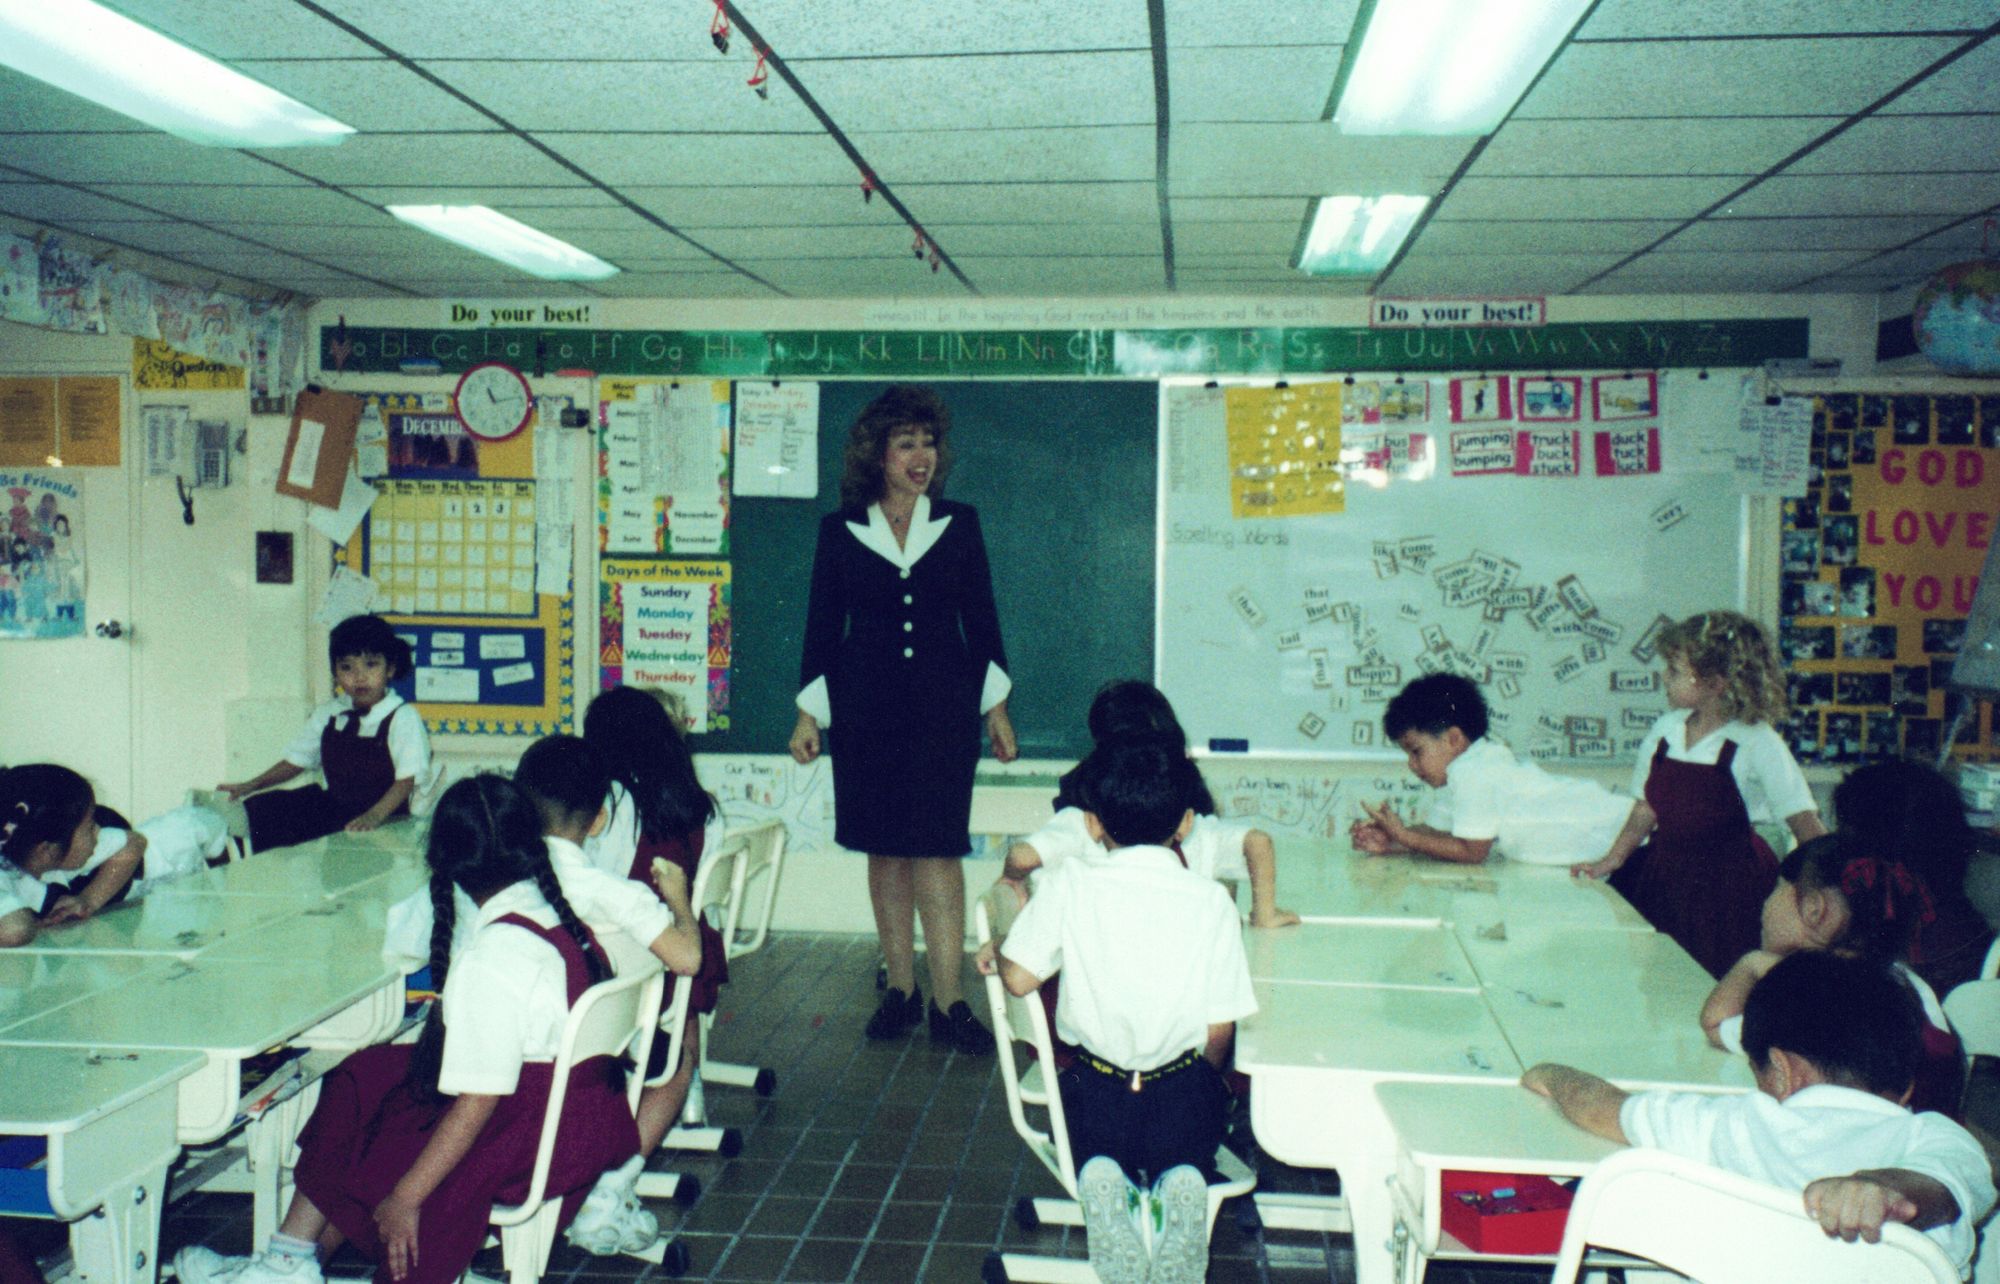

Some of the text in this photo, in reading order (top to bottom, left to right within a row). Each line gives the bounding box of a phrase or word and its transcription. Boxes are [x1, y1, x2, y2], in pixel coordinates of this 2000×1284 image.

[452, 304, 590, 326] Do your best!
[1380, 303, 1534, 325] Do your best!
[1456, 430, 1511, 451] jumping
[1532, 430, 1571, 446] truck
[1611, 429, 1646, 445] duck
[1454, 451, 1512, 467] bumping
[1881, 448, 1985, 489] GOD
[23, 473, 78, 499] Friends
[1866, 509, 1989, 548] LOVE
[606, 564, 724, 579] Days of the Week
[640, 586, 691, 600] Sunday
[1884, 572, 1981, 614] YOU
[637, 607, 695, 622] Monday
[638, 627, 692, 643] Tuesday
[625, 649, 706, 665] Wednesday
[634, 669, 697, 685] Thursday
[1618, 676, 1649, 688] card
[725, 763, 773, 776] Our Town
[1238, 777, 1291, 791] Our Town
[1373, 777, 1426, 792] Our Town
